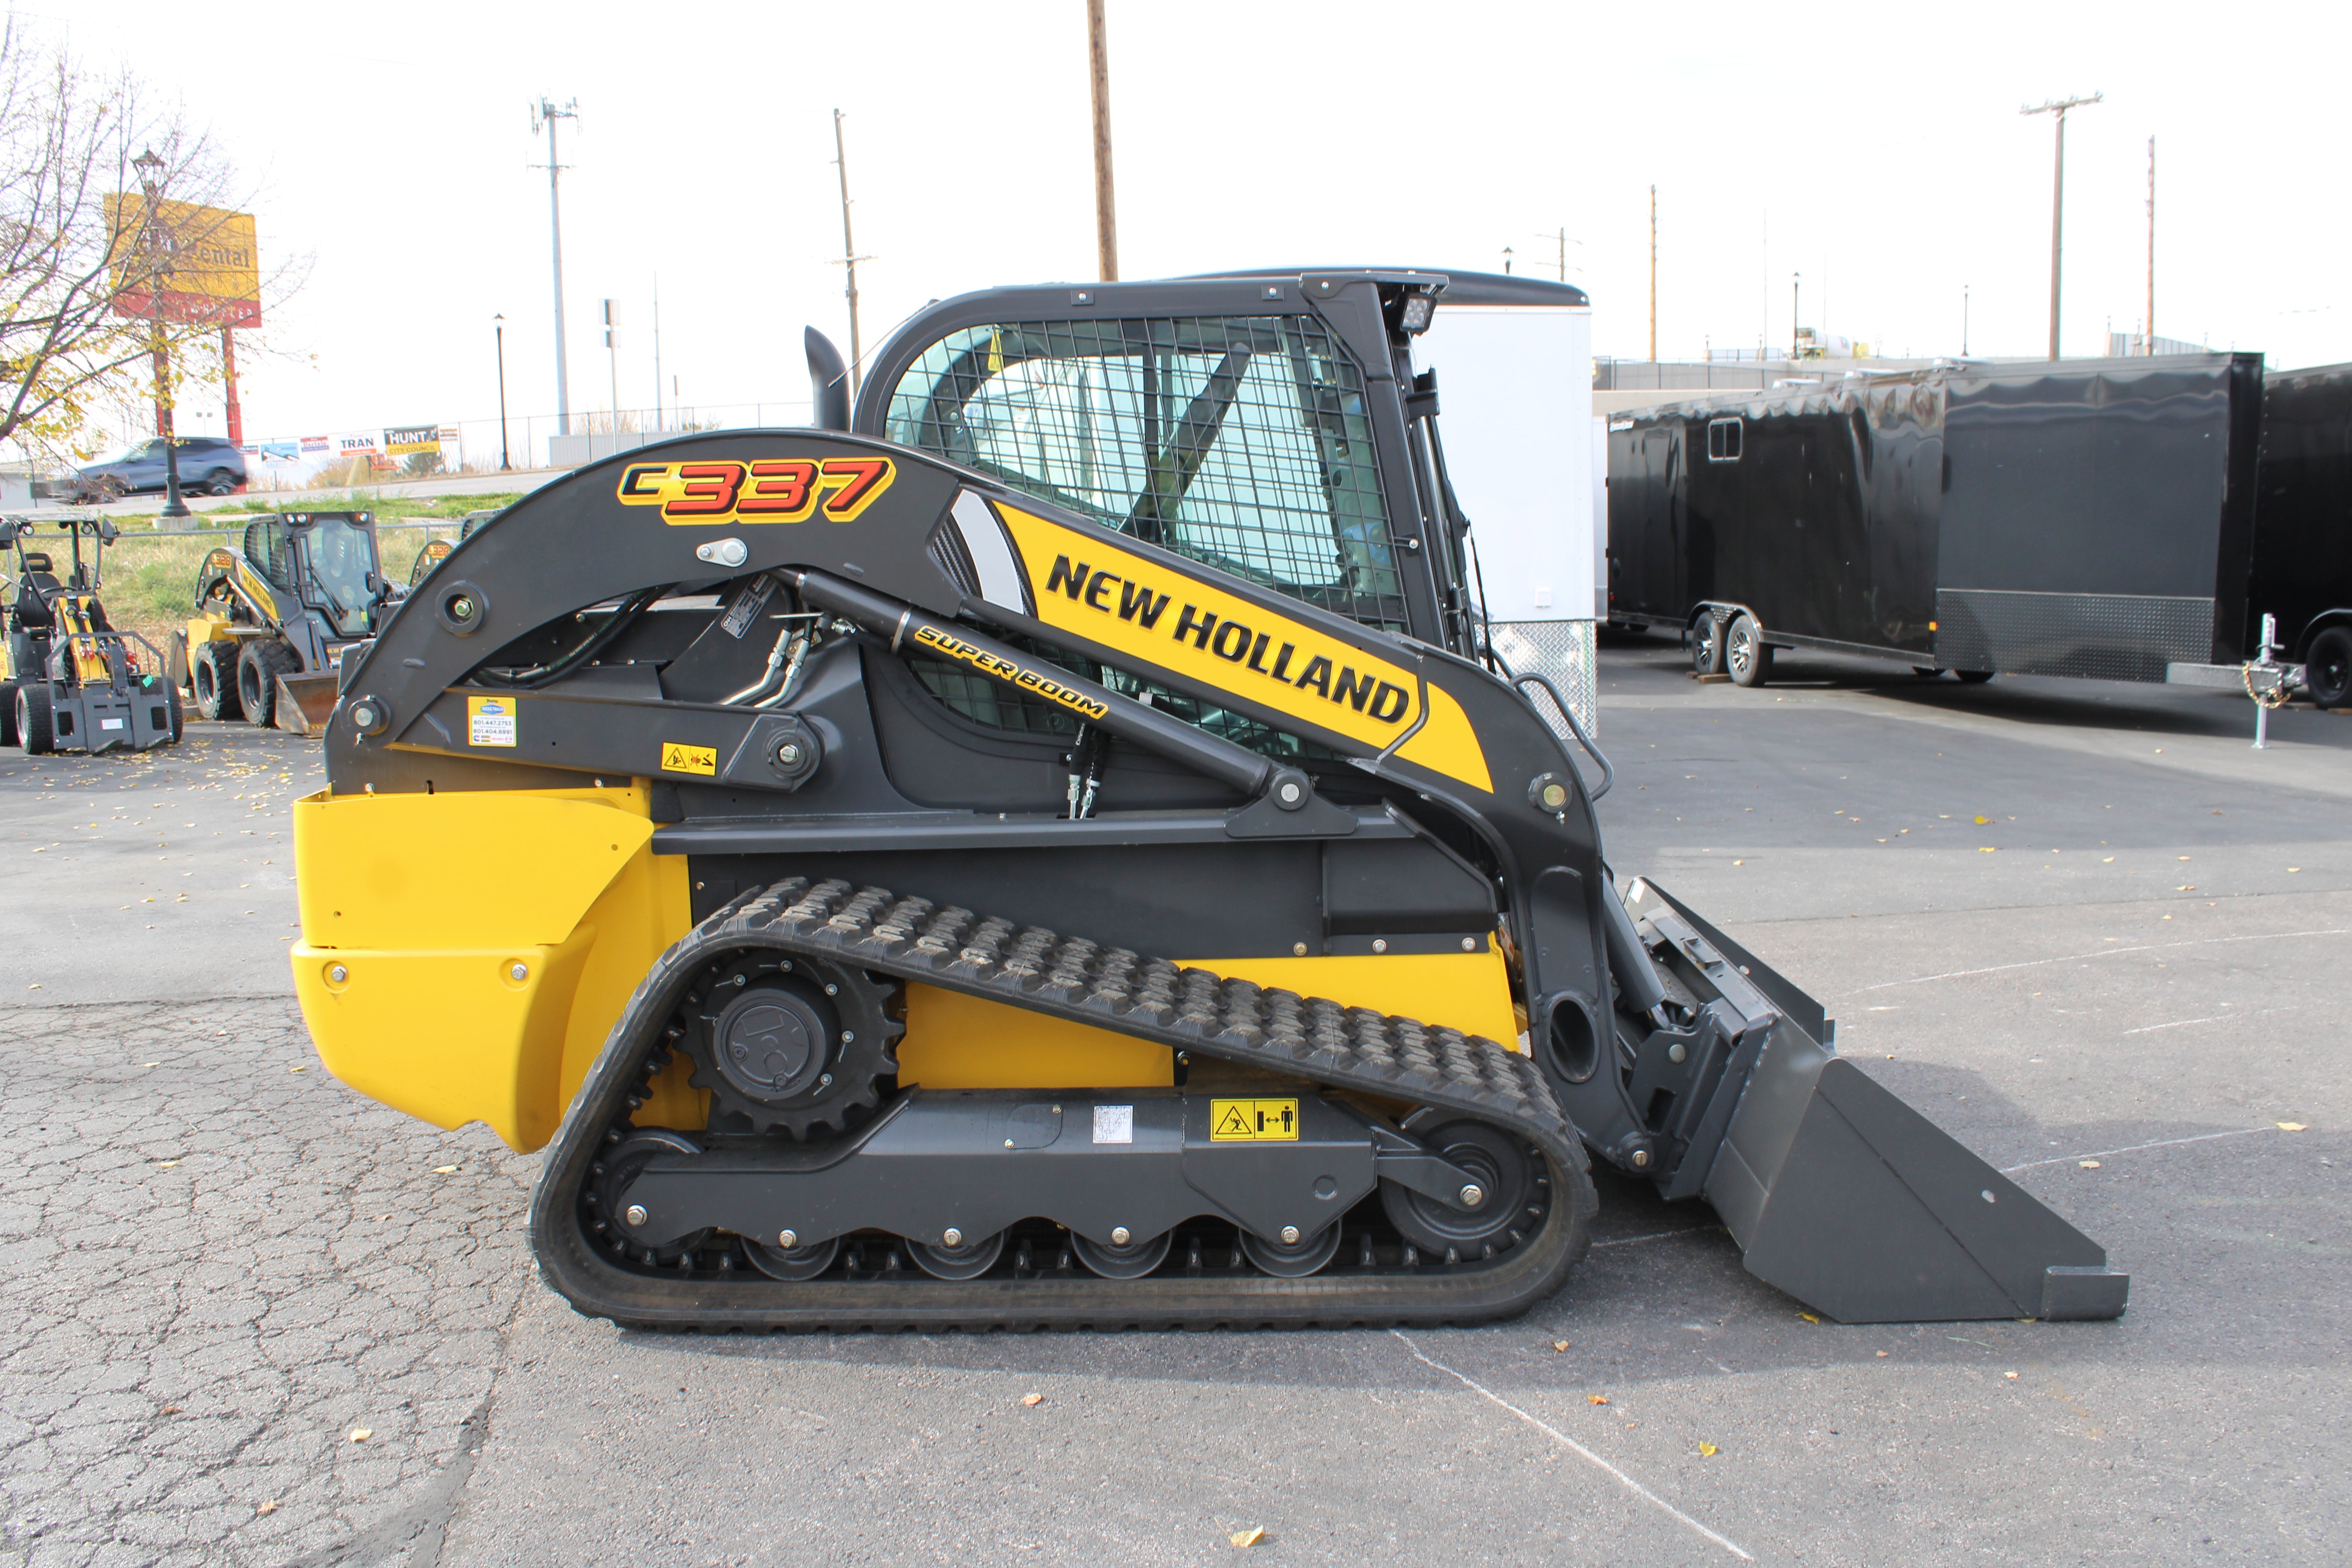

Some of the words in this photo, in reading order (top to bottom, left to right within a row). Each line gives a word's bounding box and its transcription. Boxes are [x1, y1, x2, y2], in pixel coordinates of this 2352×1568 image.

[341, 437, 374, 449] TRAN
[390, 431, 427, 445] HUNT
[1044, 553, 1171, 630] NEW
[1172, 602, 1410, 725] HOLLAND
[915, 626, 1018, 680] SUPER
[1016, 670, 1108, 719] BOOM
